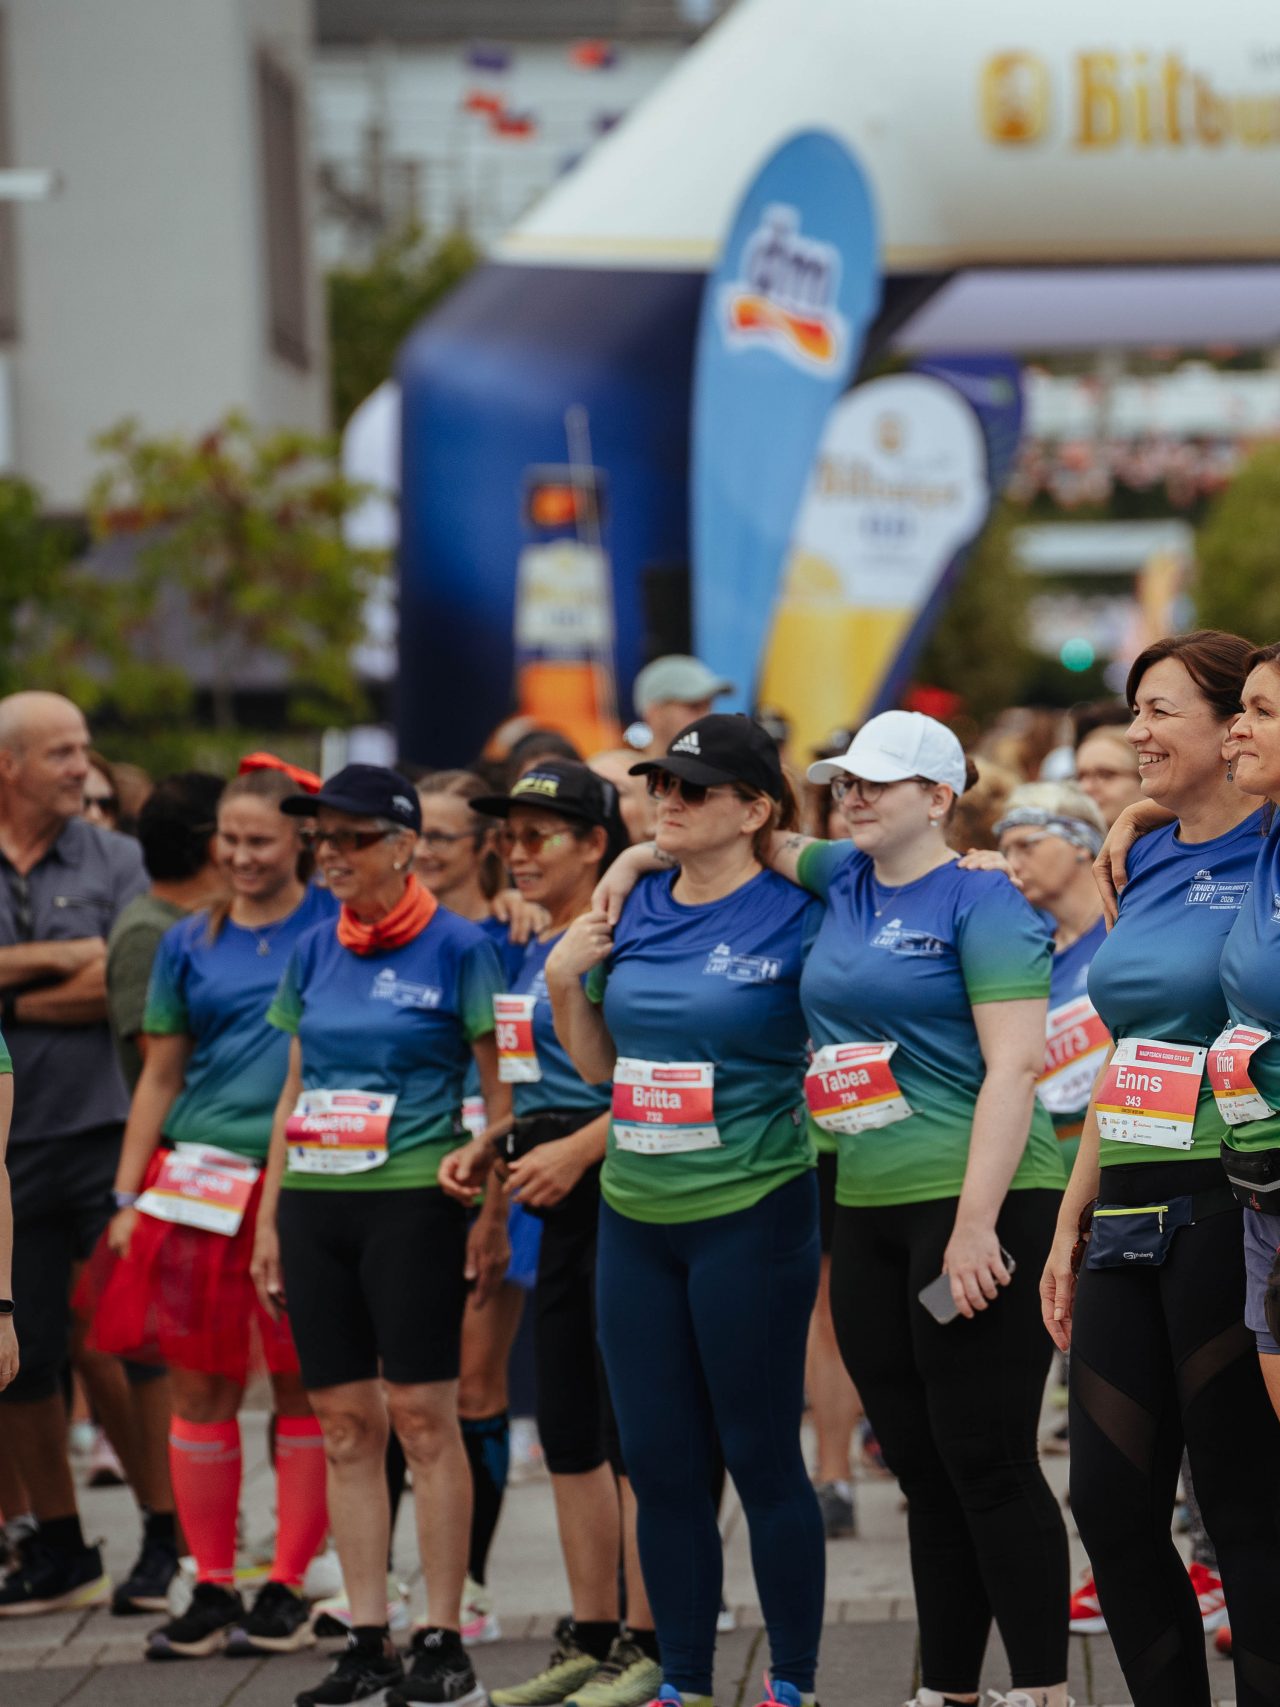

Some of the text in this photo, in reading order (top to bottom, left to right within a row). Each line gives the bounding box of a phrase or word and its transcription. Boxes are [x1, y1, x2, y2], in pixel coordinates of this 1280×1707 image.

[1188, 892, 1213, 902] LAUF
[817, 1068, 871, 1093] Tabea
[1116, 1066, 1163, 1093] Enns
[632, 1086, 682, 1109] Britta
[1125, 1095, 1142, 1107] 343
